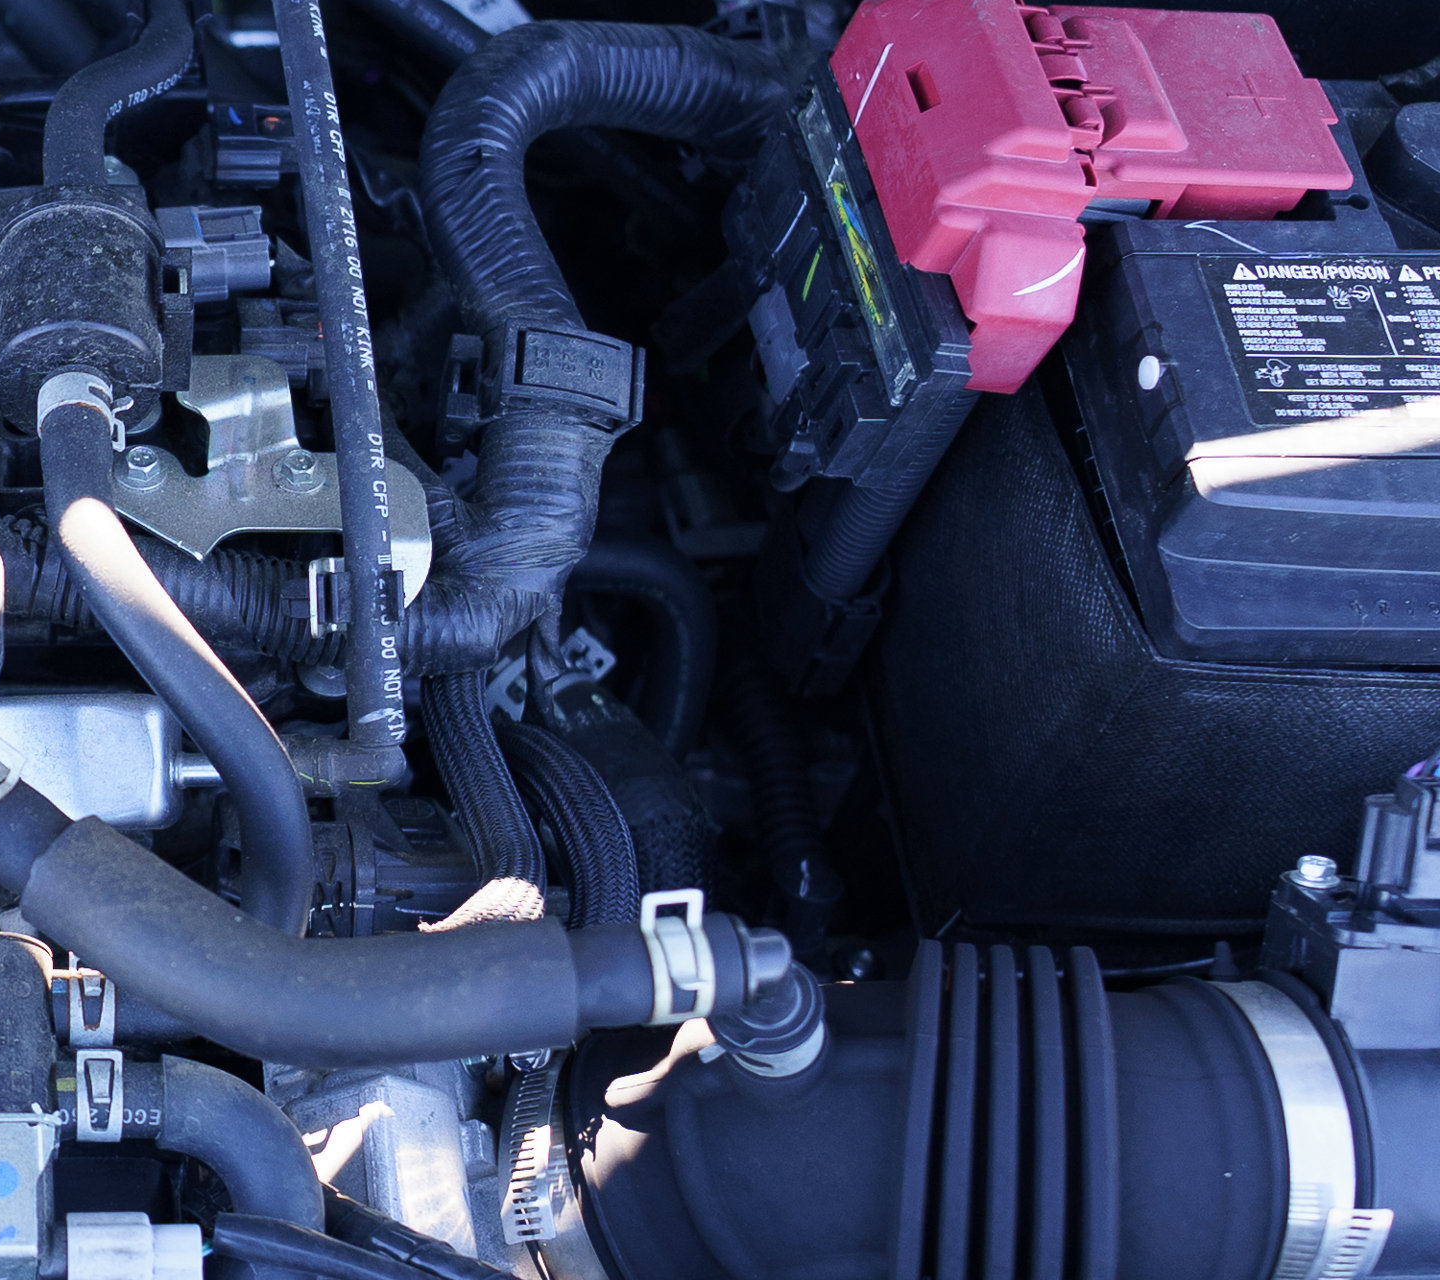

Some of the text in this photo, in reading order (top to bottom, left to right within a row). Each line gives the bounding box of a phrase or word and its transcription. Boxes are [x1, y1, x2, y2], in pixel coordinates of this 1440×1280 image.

[1254, 264, 1391, 281] DANGER/POISON
[351, 286, 368, 320] NOT
[356, 325, 375, 370] KINK
[372, 480, 389, 518] CFP
[381, 635, 396, 659] DO
[383, 669, 403, 701] NOT
